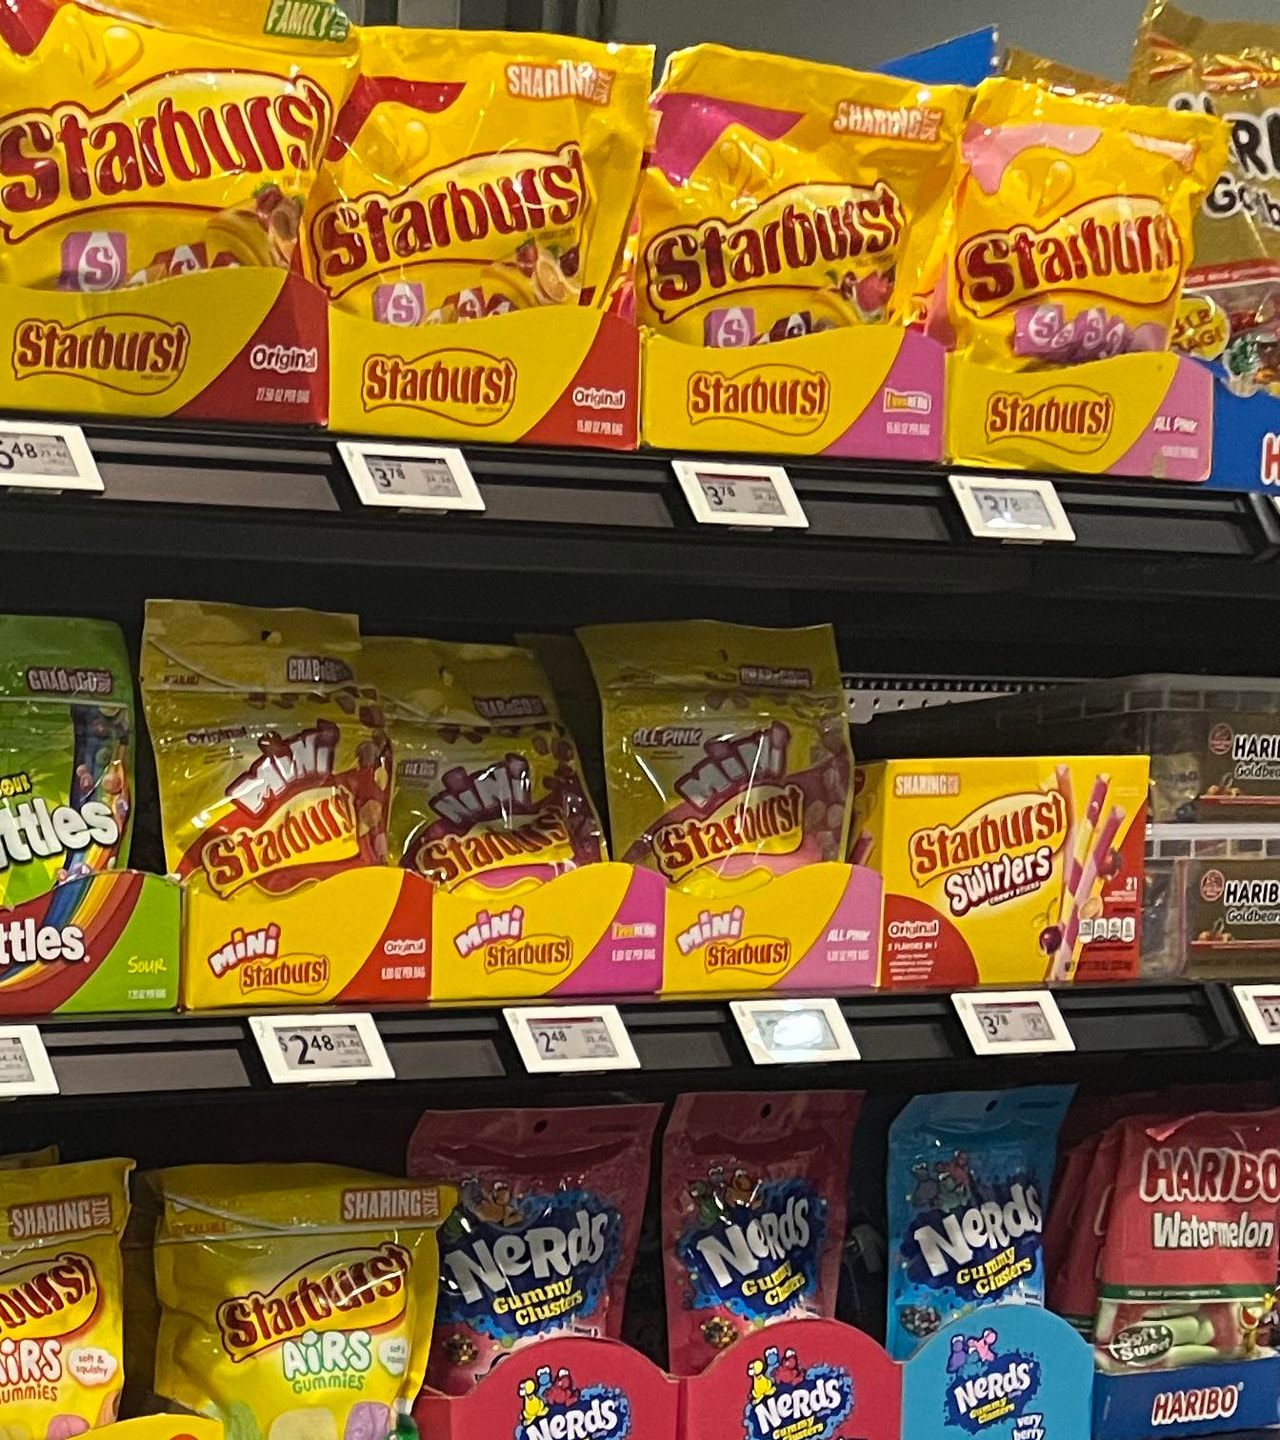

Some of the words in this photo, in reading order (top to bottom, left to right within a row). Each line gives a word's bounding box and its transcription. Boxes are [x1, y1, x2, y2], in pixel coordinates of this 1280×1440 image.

[15, 322, 187, 378] Starburst
[251, 346, 317, 374] Original
[363, 360, 514, 414] Starburst
[986, 393, 1112, 438] Starburst
[948, 848, 1050, 913] Swirlers
[888, 921, 938, 937] Original
[241, 958, 328, 990] Starburst
[12, 1205, 91, 1238] SHARING
[1154, 1213, 1274, 1251] Watermelon
[1016, 1416, 1042, 1431] very
[1151, 1385, 1238, 1424] HARIBO
